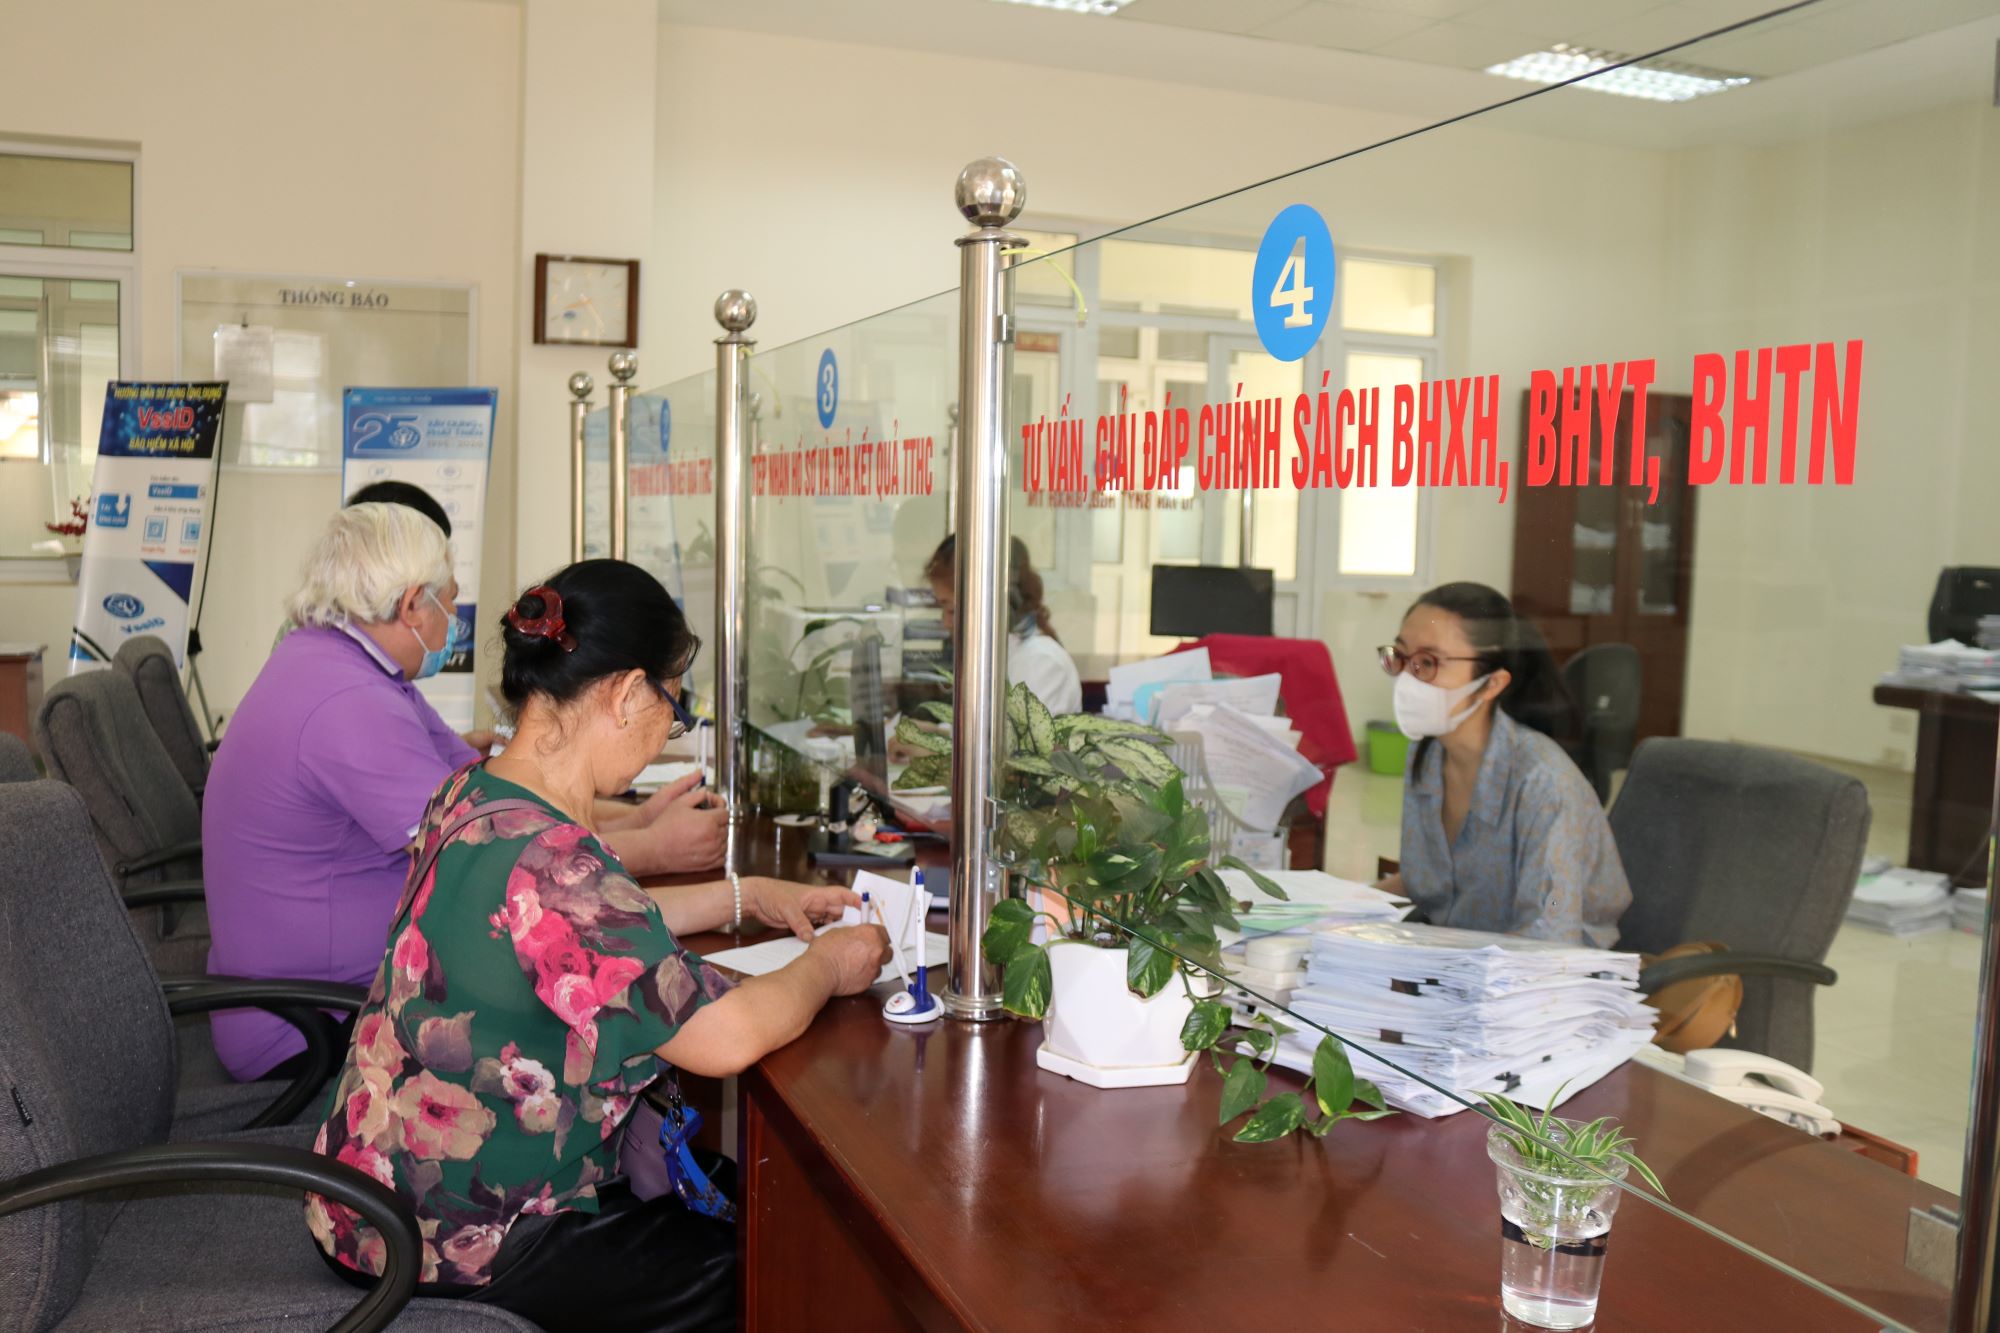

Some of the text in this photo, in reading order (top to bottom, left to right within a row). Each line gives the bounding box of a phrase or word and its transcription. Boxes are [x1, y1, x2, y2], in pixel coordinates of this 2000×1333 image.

[278, 286, 389, 307] THÔNG BÁO
[1270, 235, 1314, 329] 4
[822, 363, 835, 413] 3
[137, 406, 195, 431] VssID
[353, 412, 422, 453] 25
[1021, 339, 1863, 504] TƯ VẤN, GIẢI ĐÁP CHÍNH SÁCH BHXH, BHYT, BHTN
[805, 445, 817, 496] SƠ
[819, 437, 830, 496] VÀ
[833, 427, 850, 496] TRẢ
[854, 426, 873, 496] KẾT
[876, 419, 899, 502] QUẢ
[903, 436, 933, 496] TTHC
